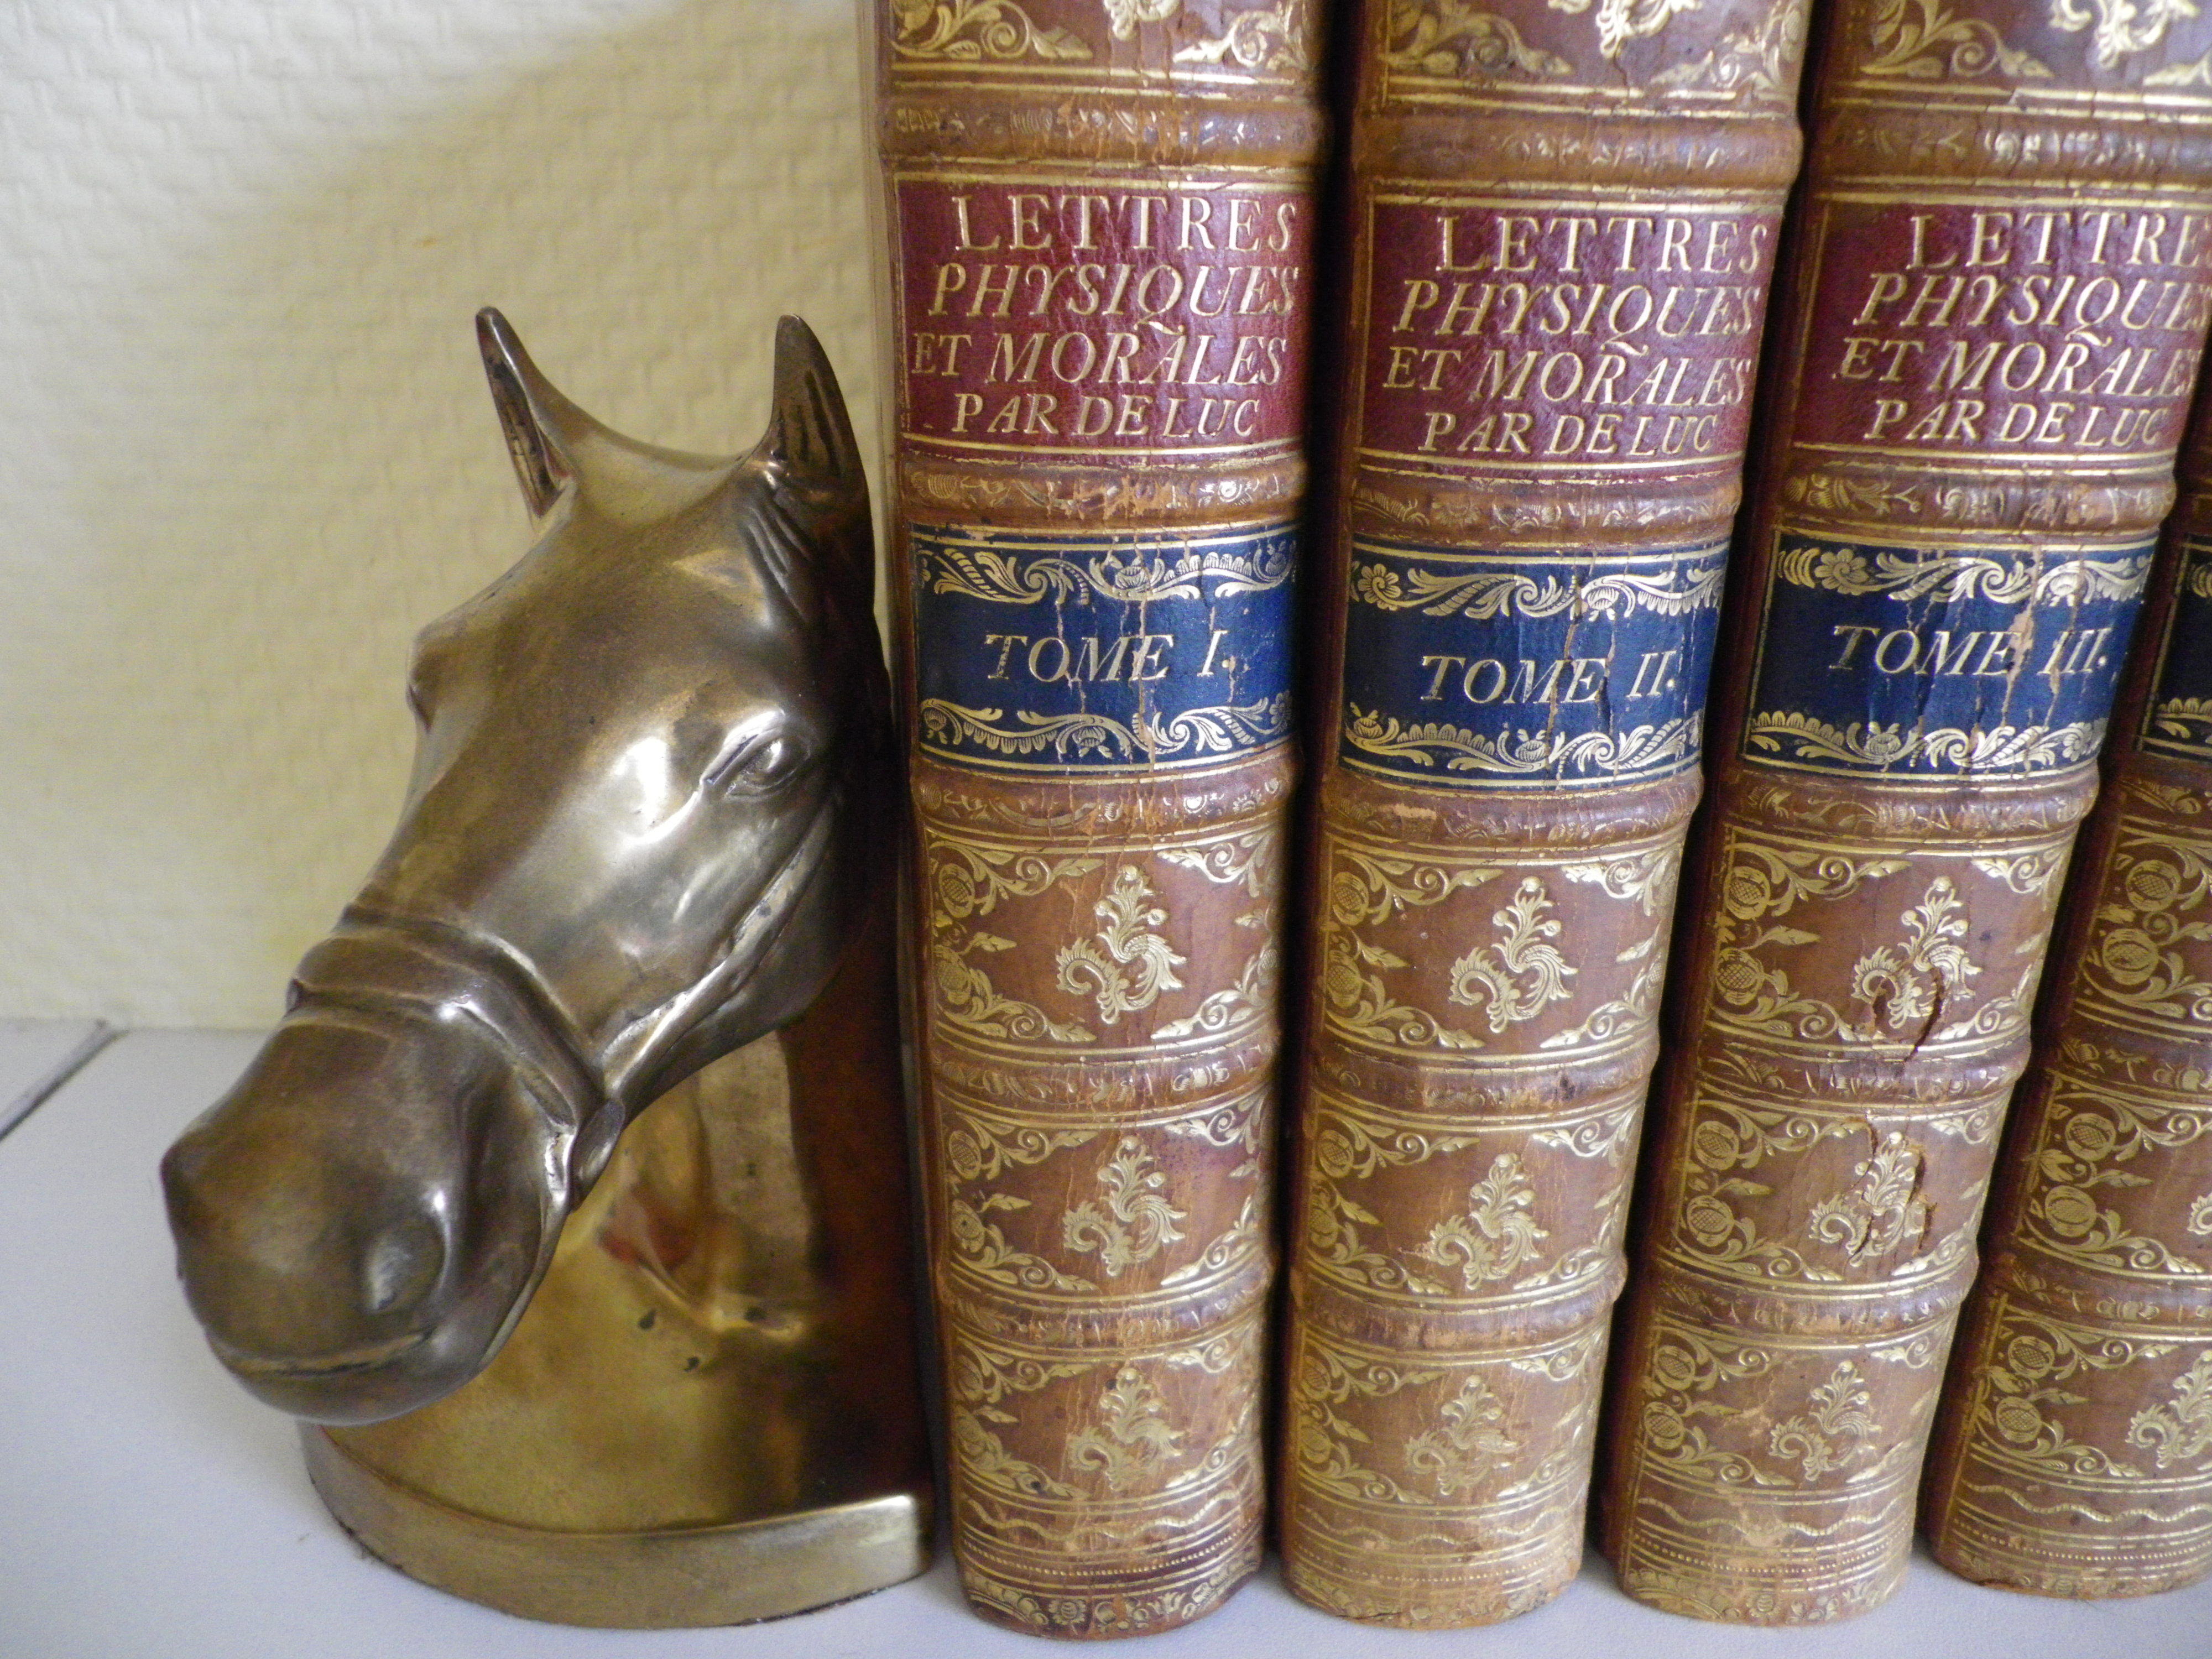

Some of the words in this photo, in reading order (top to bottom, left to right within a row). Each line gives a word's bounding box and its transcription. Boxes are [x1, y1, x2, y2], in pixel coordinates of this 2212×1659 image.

[951, 194, 1297, 252] LETTRES
[1436, 216, 1767, 274] LETTRES
[927, 263, 1300, 334] PHYSIQUES
[1392, 280, 1762, 356] PHYSIQUES
[911, 333, 972, 377] ET
[984, 331, 1287, 386] MORALES
[1383, 346, 1462, 391] ET
[1468, 349, 1752, 407] MORALES
[1840, 337, 1924, 382] ET
[951, 393, 1060, 435] PAR
[1071, 394, 1154, 436] DE
[1162, 397, 1260, 438] LUC
[1417, 411, 1534, 455] PAR
[1544, 413, 1623, 456] DE
[1630, 414, 1719, 457] LUC
[1864, 399, 1986, 441] PAR
[1994, 401, 2075, 444] DE
[2075, 405, 2169, 447] LUC
[984, 634, 1173, 682] TOME
[1197, 630, 1231, 677] I.
[1421, 655, 1606, 705] TOME
[1625, 650, 1677, 697] II.
[1829, 625, 2022, 676] TOME
[2037, 627, 2113, 676] III.
